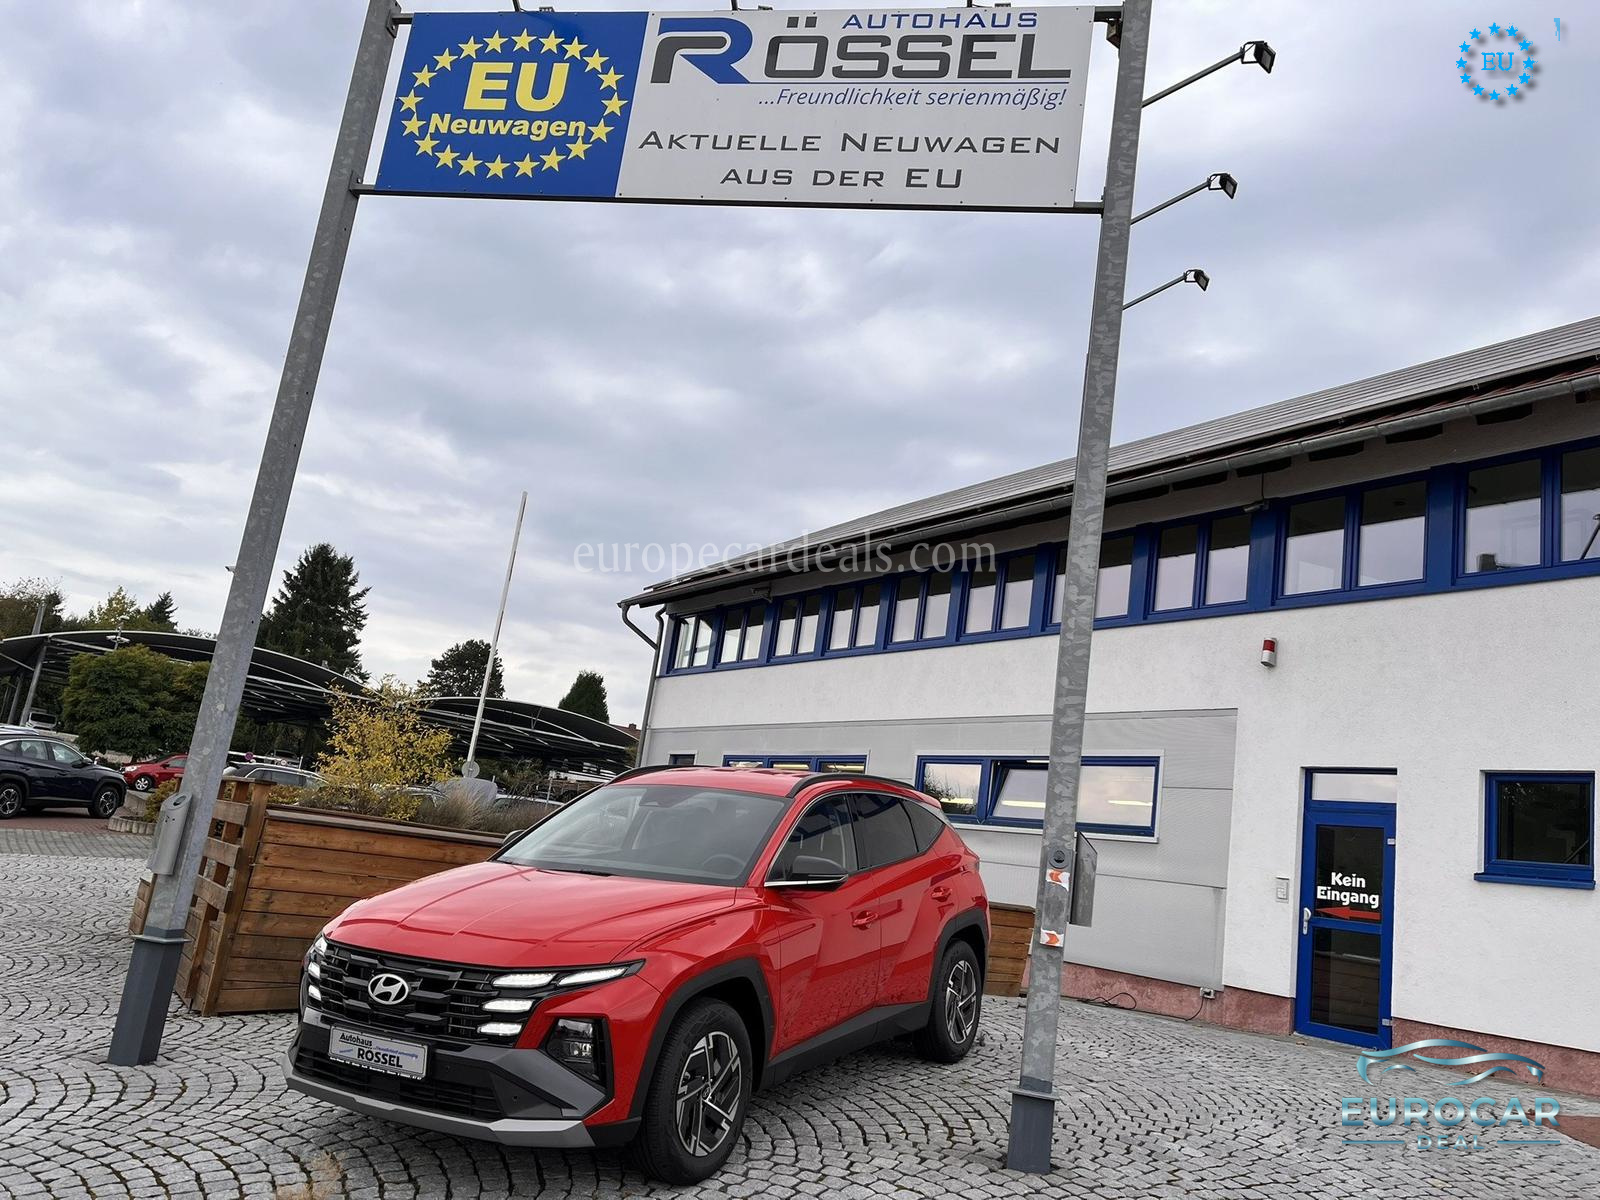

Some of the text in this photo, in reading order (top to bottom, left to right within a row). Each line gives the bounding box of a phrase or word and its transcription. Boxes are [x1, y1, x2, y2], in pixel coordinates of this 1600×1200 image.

[841, 12, 1038, 30] AUTOHAUS
[650, 16, 1072, 84] RÖSSEL
[463, 62, 570, 112] EU
[758, 88, 1067, 111] ...Freundlichkeit serienmäßig!
[428, 113, 587, 141] Neuwagen
[905, 168, 963, 189] EU
[1331, 872, 1366, 888] Kein
[1316, 886, 1379, 909] Eingang
[340, 1033, 372, 1047] Autohaus
